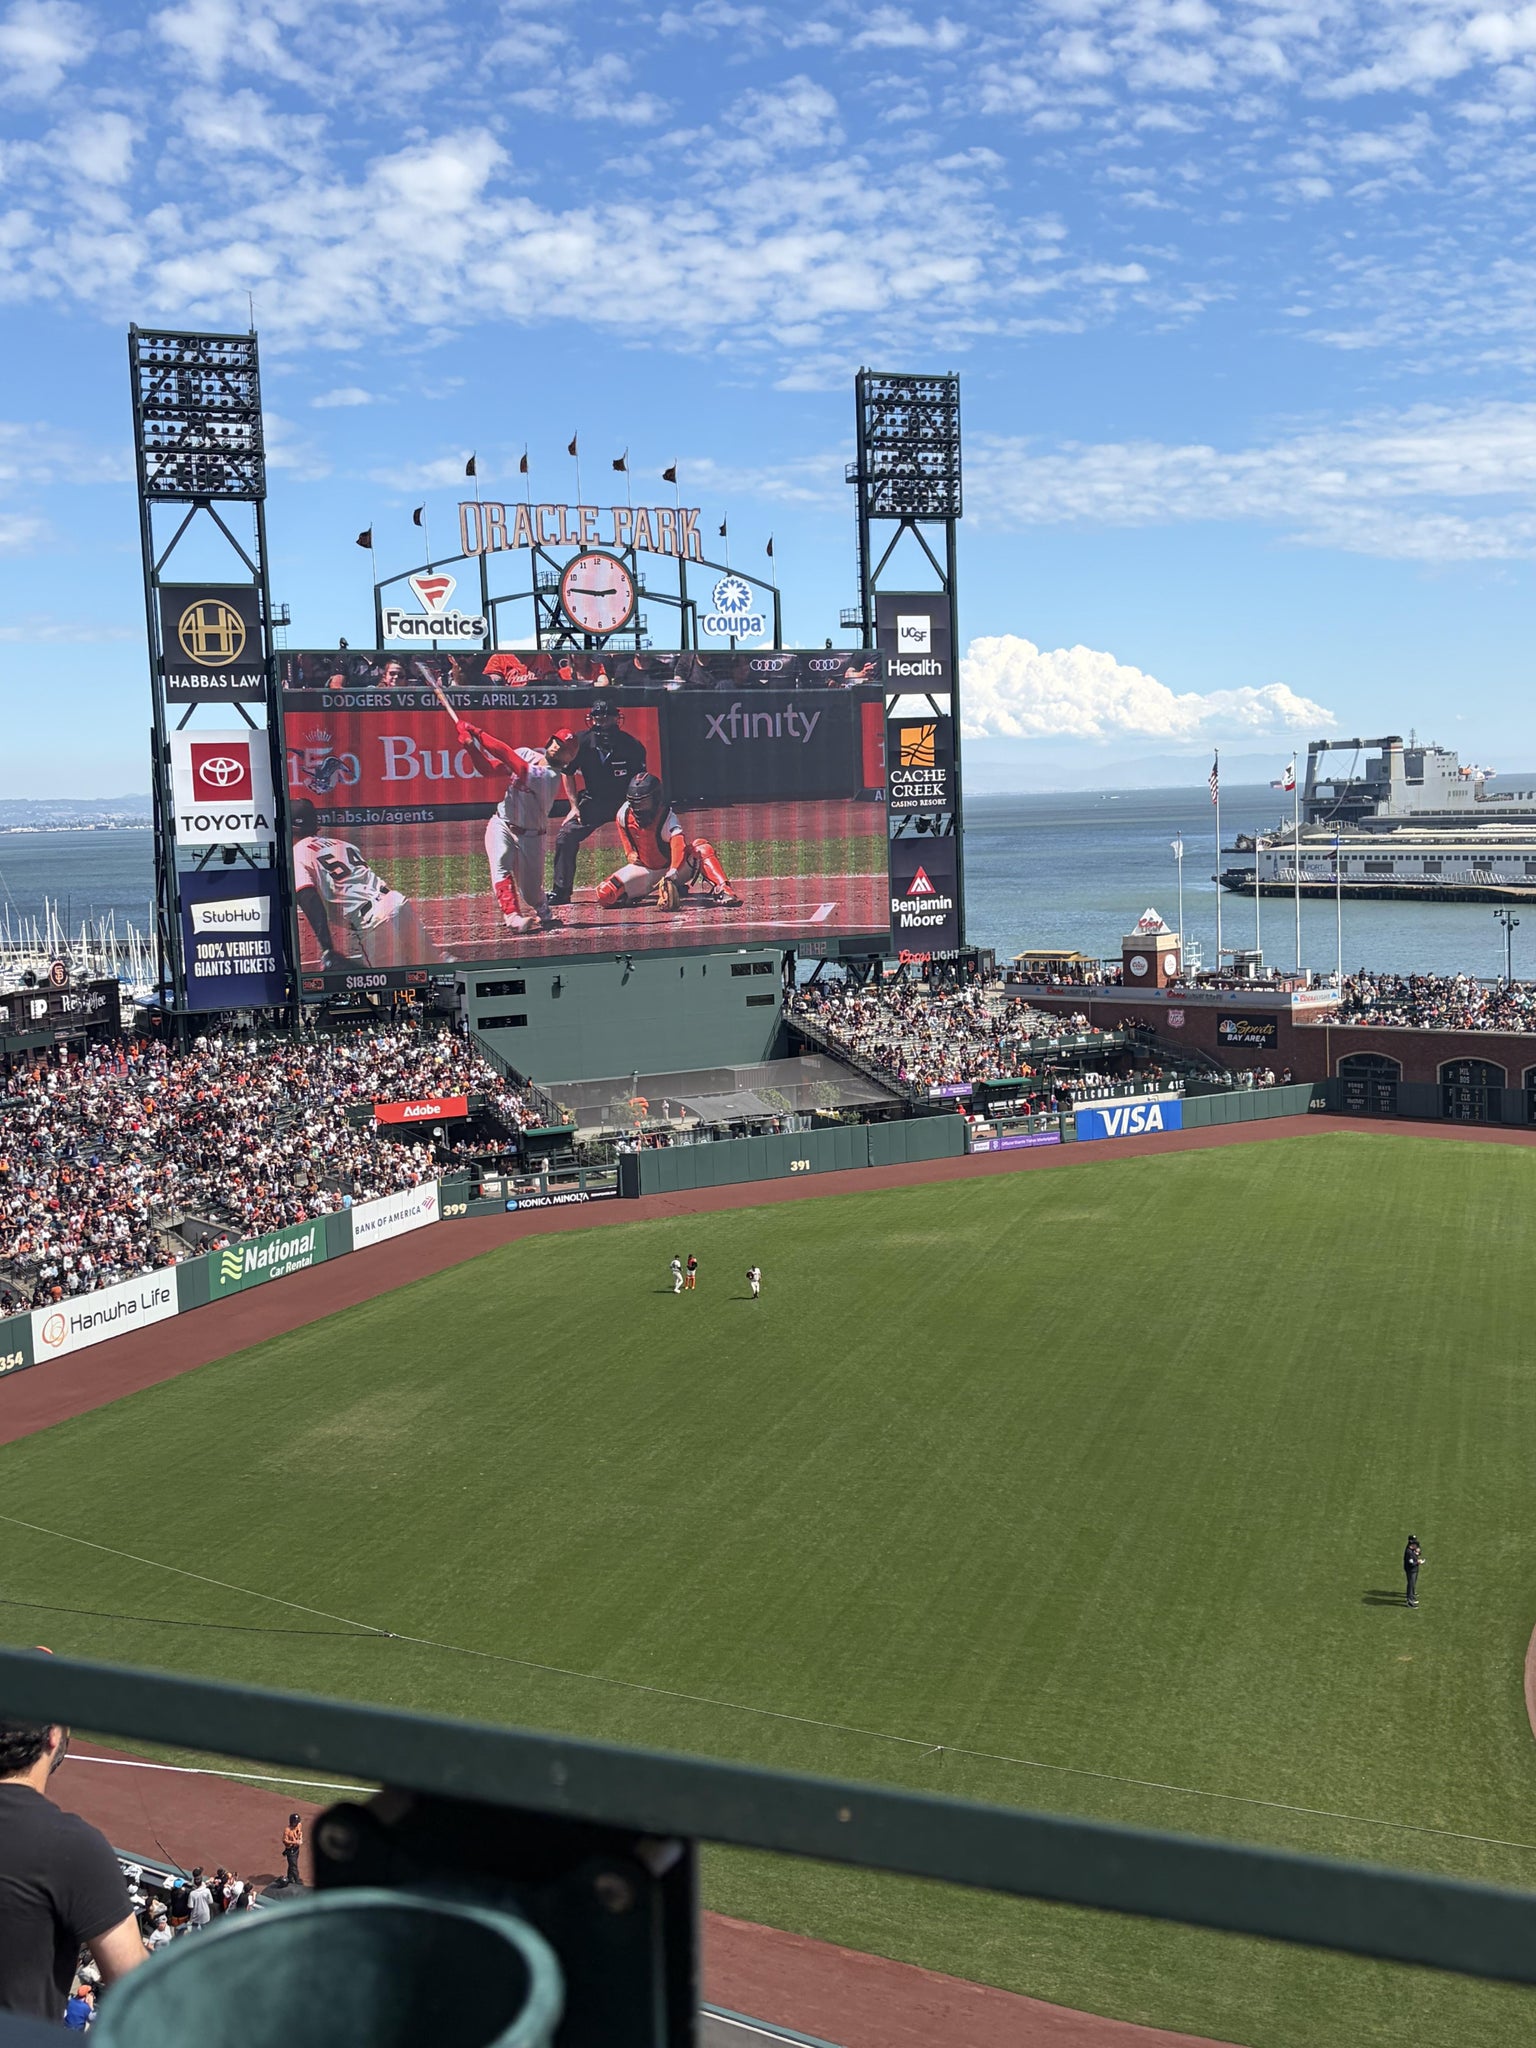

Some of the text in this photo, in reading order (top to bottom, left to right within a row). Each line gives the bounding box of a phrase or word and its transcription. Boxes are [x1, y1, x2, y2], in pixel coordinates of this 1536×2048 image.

[458, 501, 704, 563] ORACLE PARK
[594, 558, 600, 566] 12
[387, 613, 485, 636] Fanatics
[707, 616, 761, 637] coupa
[901, 626, 927, 642] UCSF
[888, 659, 942, 676] Health
[169, 674, 261, 688] HABBAS LAW
[322, 693, 392, 708] DODGERS
[397, 693, 415, 707] VS
[481, 693, 519, 707] APRIL
[522, 693, 558, 706] 21-23
[705, 702, 821, 745] xfinity
[890, 769, 947, 783] CACHE
[892, 783, 945, 798] CREEK
[891, 798, 947, 808] CASINO RESORT
[181, 814, 269, 832] TOYOTA
[891, 895, 953, 915] Benjamin
[202, 909, 261, 924] StubHub
[900, 914, 945, 928] Moore
[196, 940, 271, 960] 100% VERIFIED
[932, 950, 960, 961] LIGHT
[194, 957, 276, 977] GIANTS TICKETS
[346, 974, 387, 989] $18,500
[1236, 1020, 1276, 1035] Sports
[1227, 1034, 1266, 1043] BAY AREA
[1071, 1080, 1185, 1100] WELCOME TO THE 415
[403, 1104, 441, 1117] Adobe
[1309, 1098, 1326, 1108] 415
[1097, 1104, 1164, 1136] VISA
[790, 1160, 810, 1172] 391
[518, 1197, 551, 1209] KONICA
[553, 1193, 589, 1204] MINOLTA
[442, 1203, 467, 1216] 399
[355, 1206, 421, 1236] BANK OF AMERICA
[244, 1227, 315, 1273] National
[270, 1254, 313, 1279] Car Rental
[70, 1288, 170, 1334] Hanwha Life
[0, 1351, 24, 1372] 354
